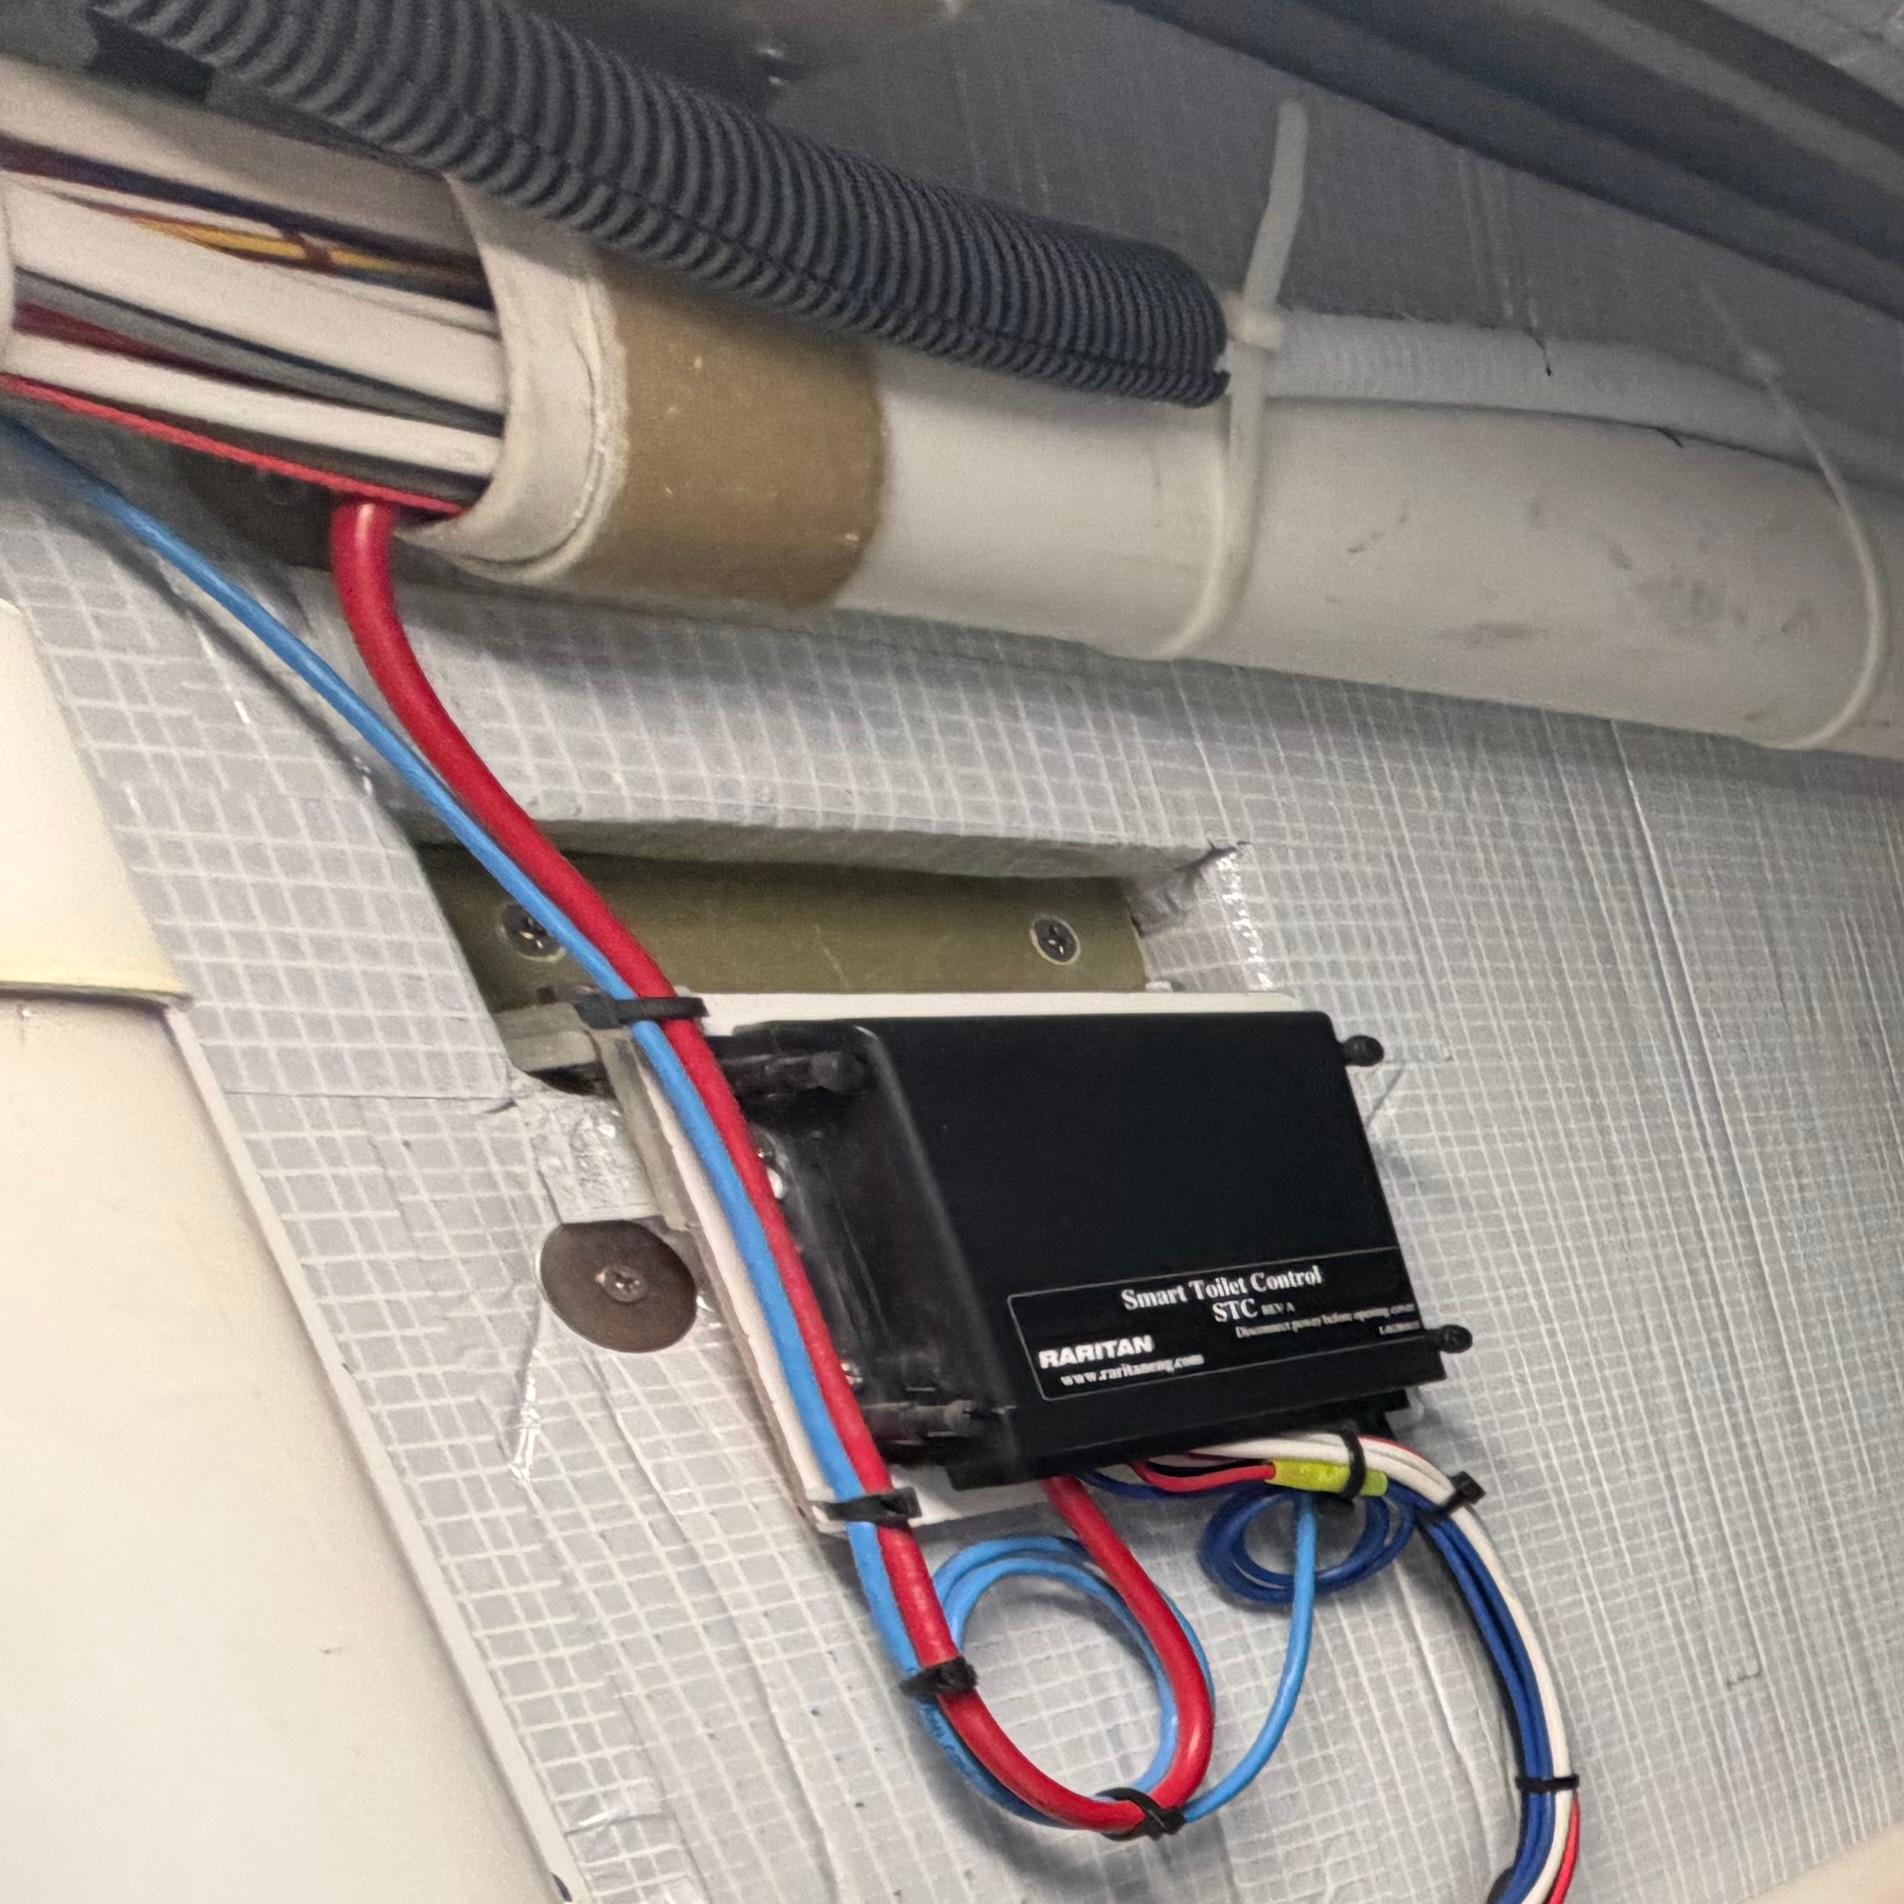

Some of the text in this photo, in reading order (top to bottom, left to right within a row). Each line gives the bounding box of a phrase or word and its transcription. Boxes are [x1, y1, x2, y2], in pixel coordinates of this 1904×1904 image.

[1121, 1264, 1323, 1310] Smart Toilet Control
[1212, 1298, 1258, 1322] STC
[1038, 1334, 1155, 1369] RARITAN
